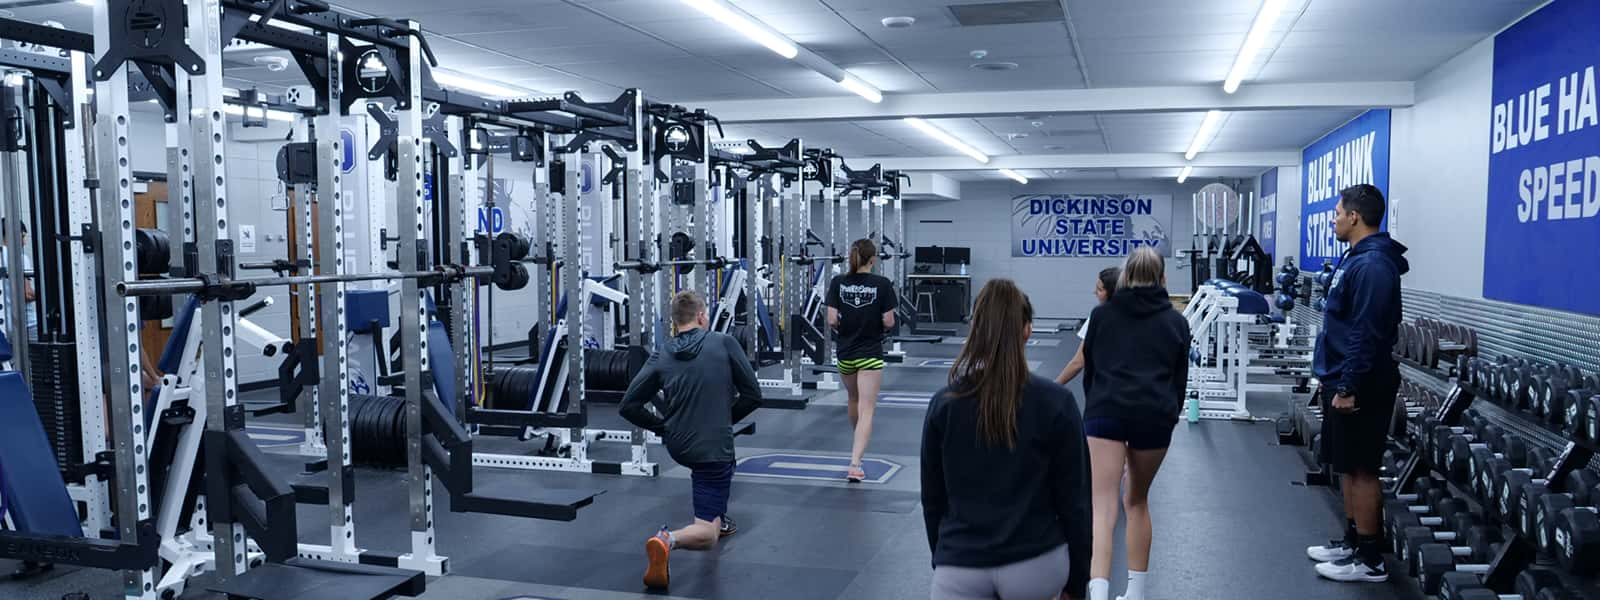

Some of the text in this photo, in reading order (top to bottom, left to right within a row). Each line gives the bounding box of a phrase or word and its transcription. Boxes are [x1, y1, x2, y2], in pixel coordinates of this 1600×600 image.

[1492, 83, 1551, 154] BLUE
[1307, 131, 1376, 205] BLUE HAWK
[1517, 156, 1600, 223] SPEED
[1029, 198, 1153, 216] DICKINSON
[1055, 218, 1125, 236] STATE
